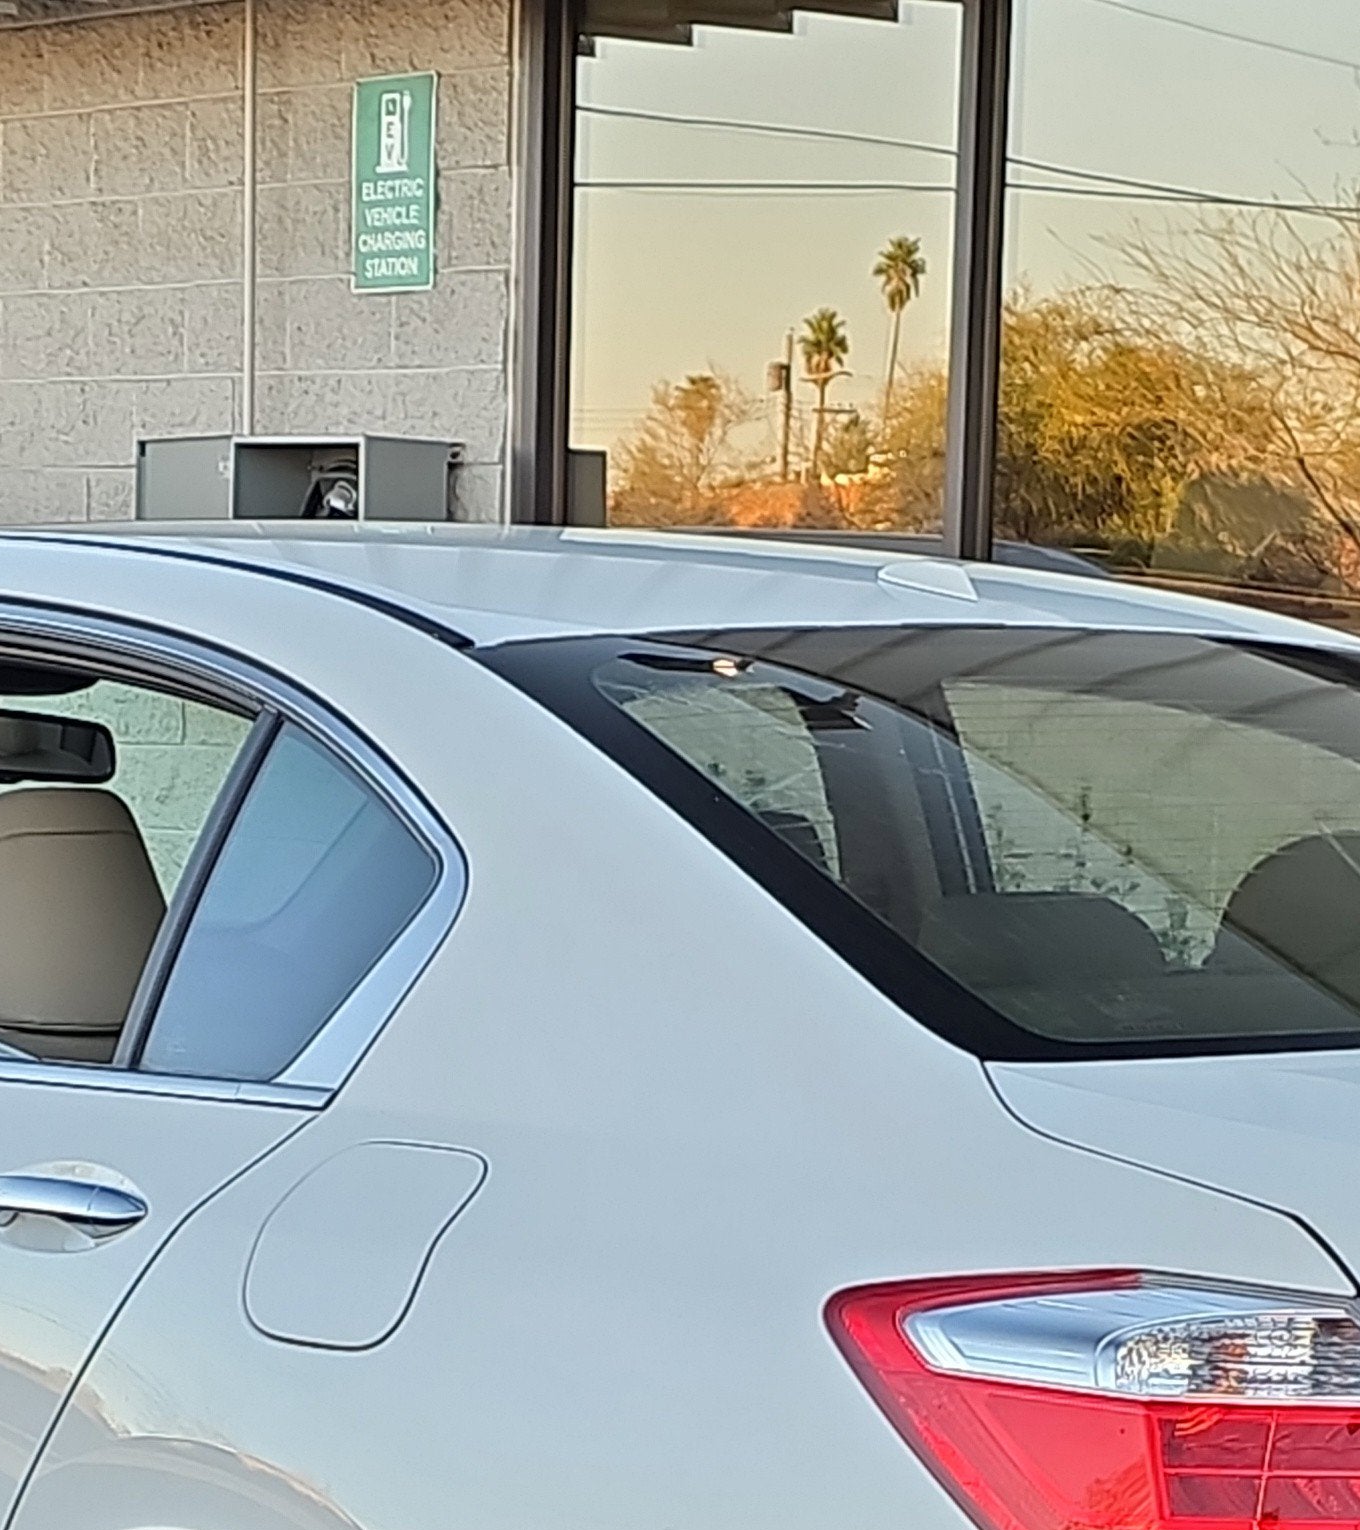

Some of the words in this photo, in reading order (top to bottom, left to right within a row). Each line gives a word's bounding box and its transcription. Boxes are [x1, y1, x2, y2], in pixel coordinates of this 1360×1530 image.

[361, 178, 425, 202] ELECTRIC
[365, 205, 420, 227] VEHICLE
[358, 229, 427, 253] CHARGING
[365, 256, 419, 279] STATION
